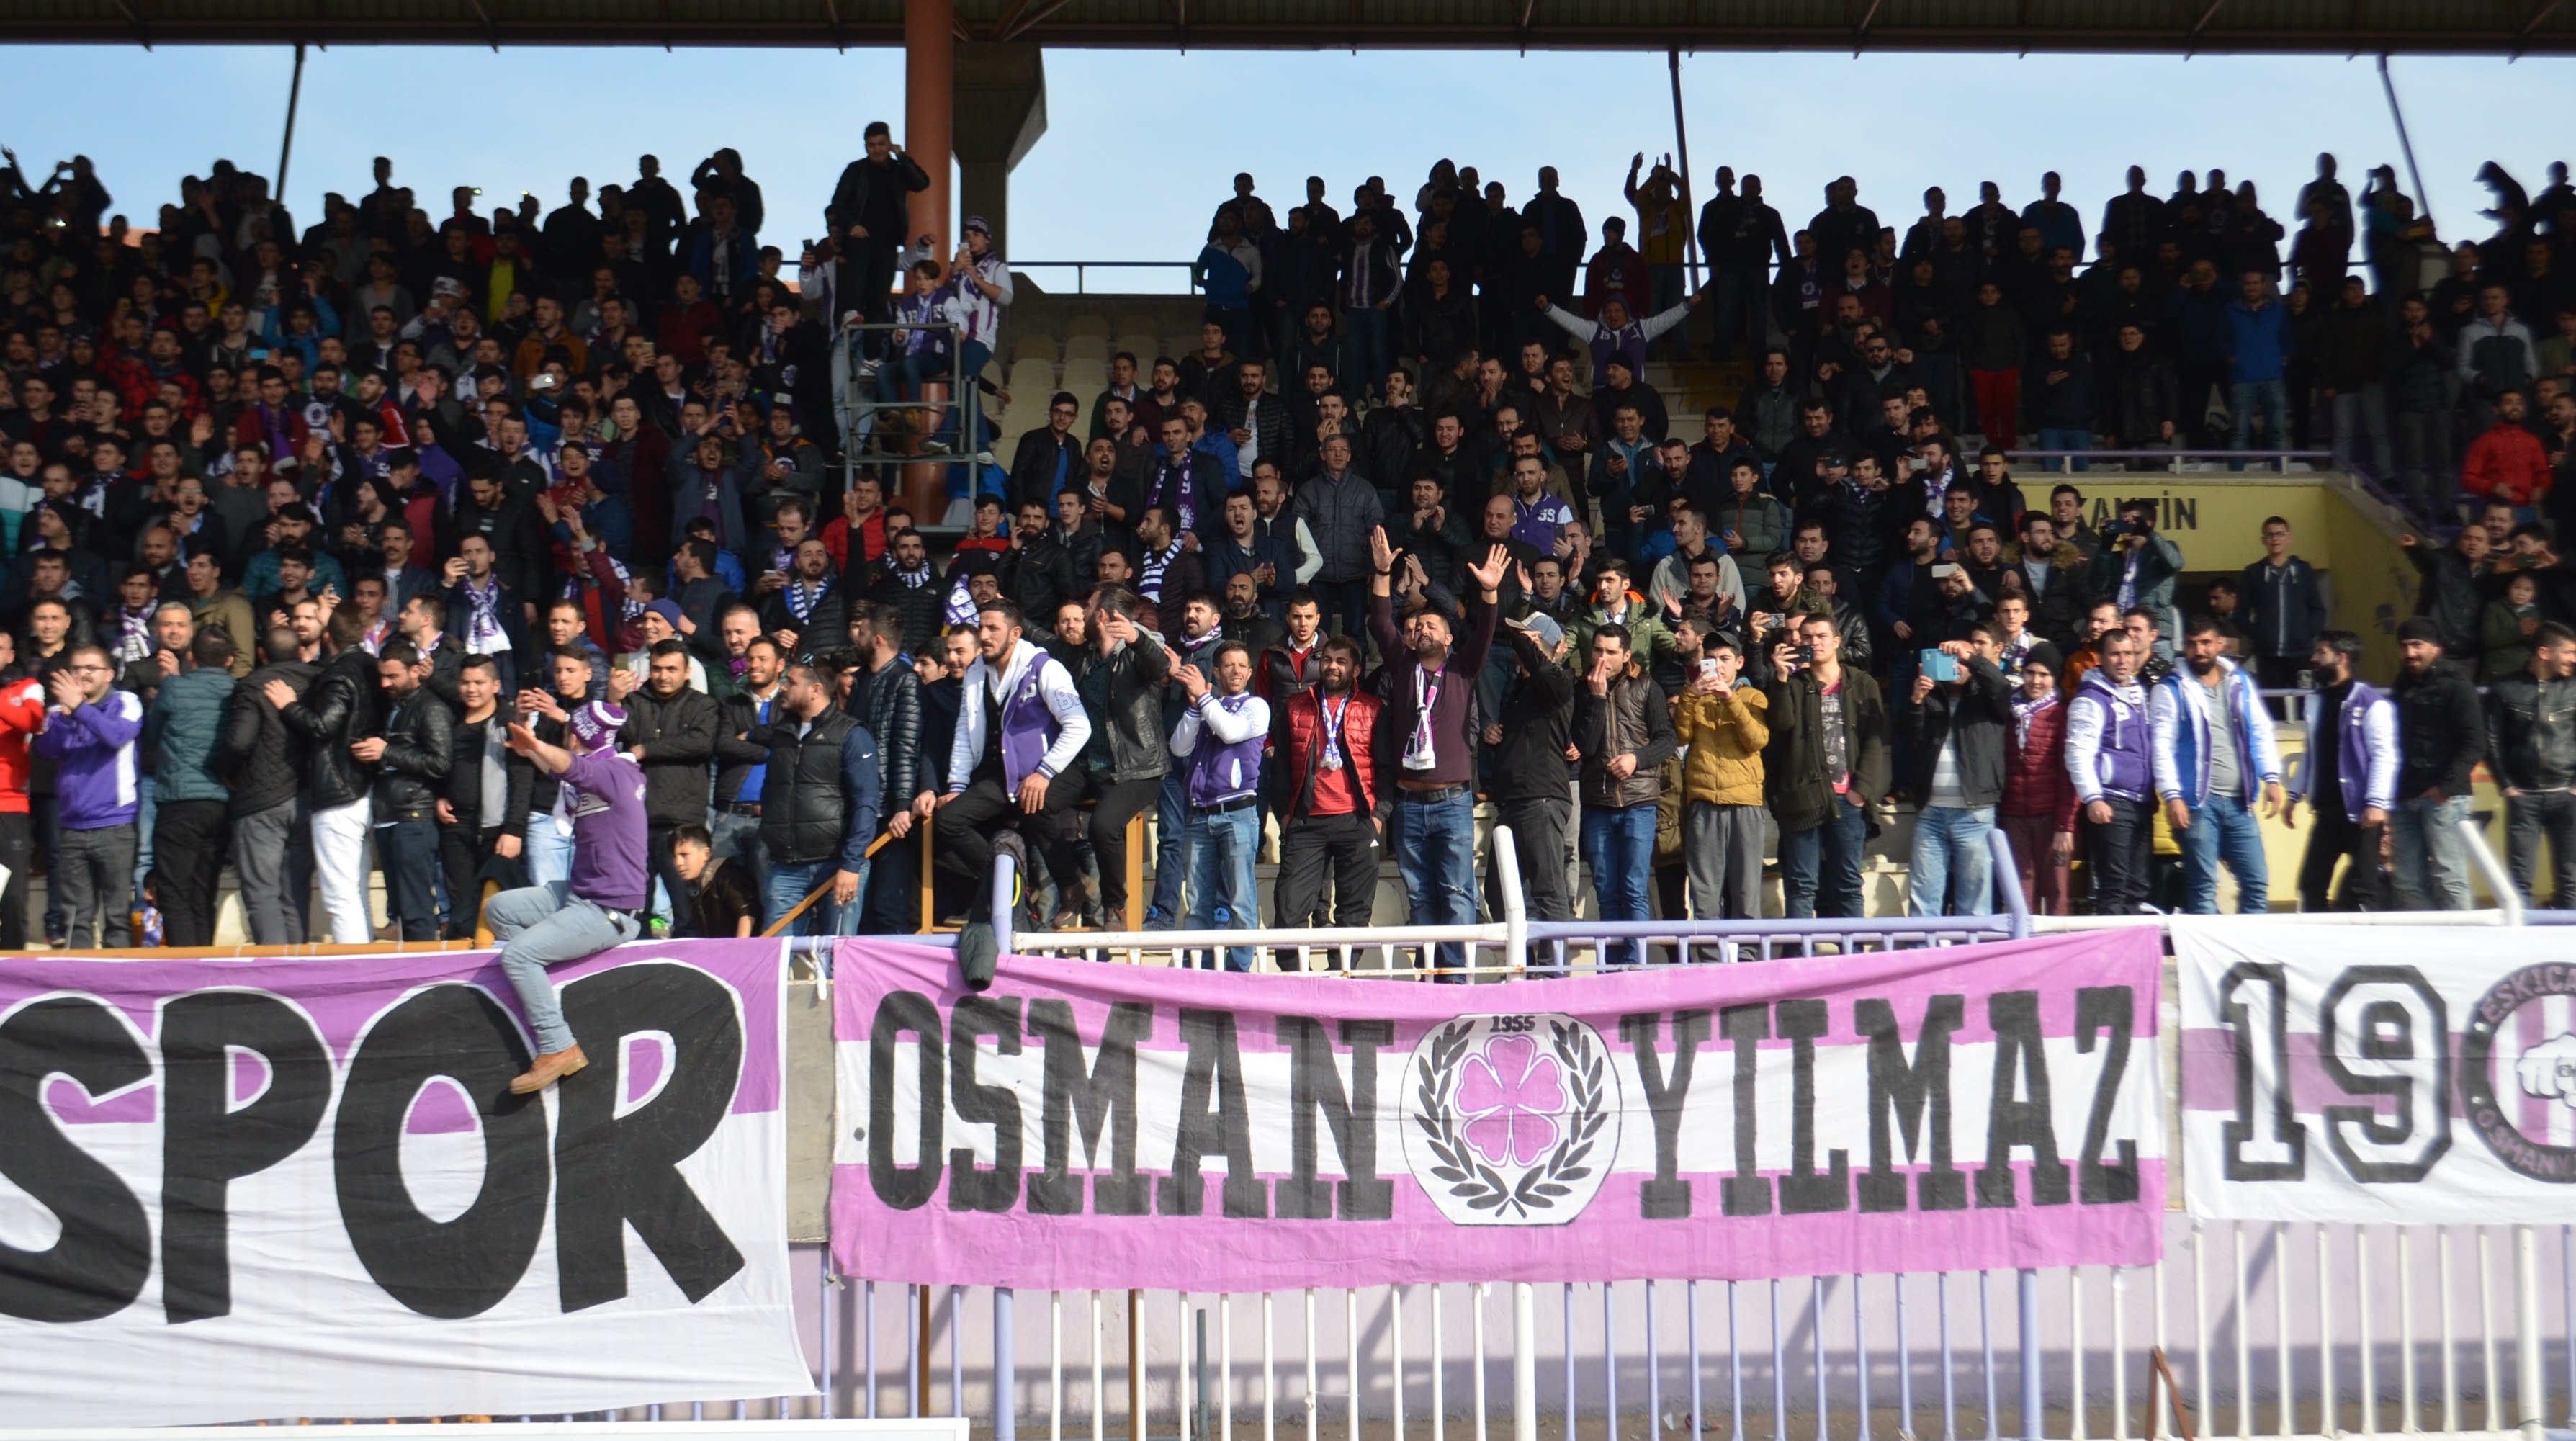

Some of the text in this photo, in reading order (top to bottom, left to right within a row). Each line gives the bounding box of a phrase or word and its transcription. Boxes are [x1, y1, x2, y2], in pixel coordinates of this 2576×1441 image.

[2078, 490, 2198, 530] AİN
[869, 984, 2140, 1221] OSMAN YILMAZ
[1489, 1015, 1536, 1033] 1955
[2219, 962, 2452, 1183] 19
[0, 959, 746, 1325] SPOR
